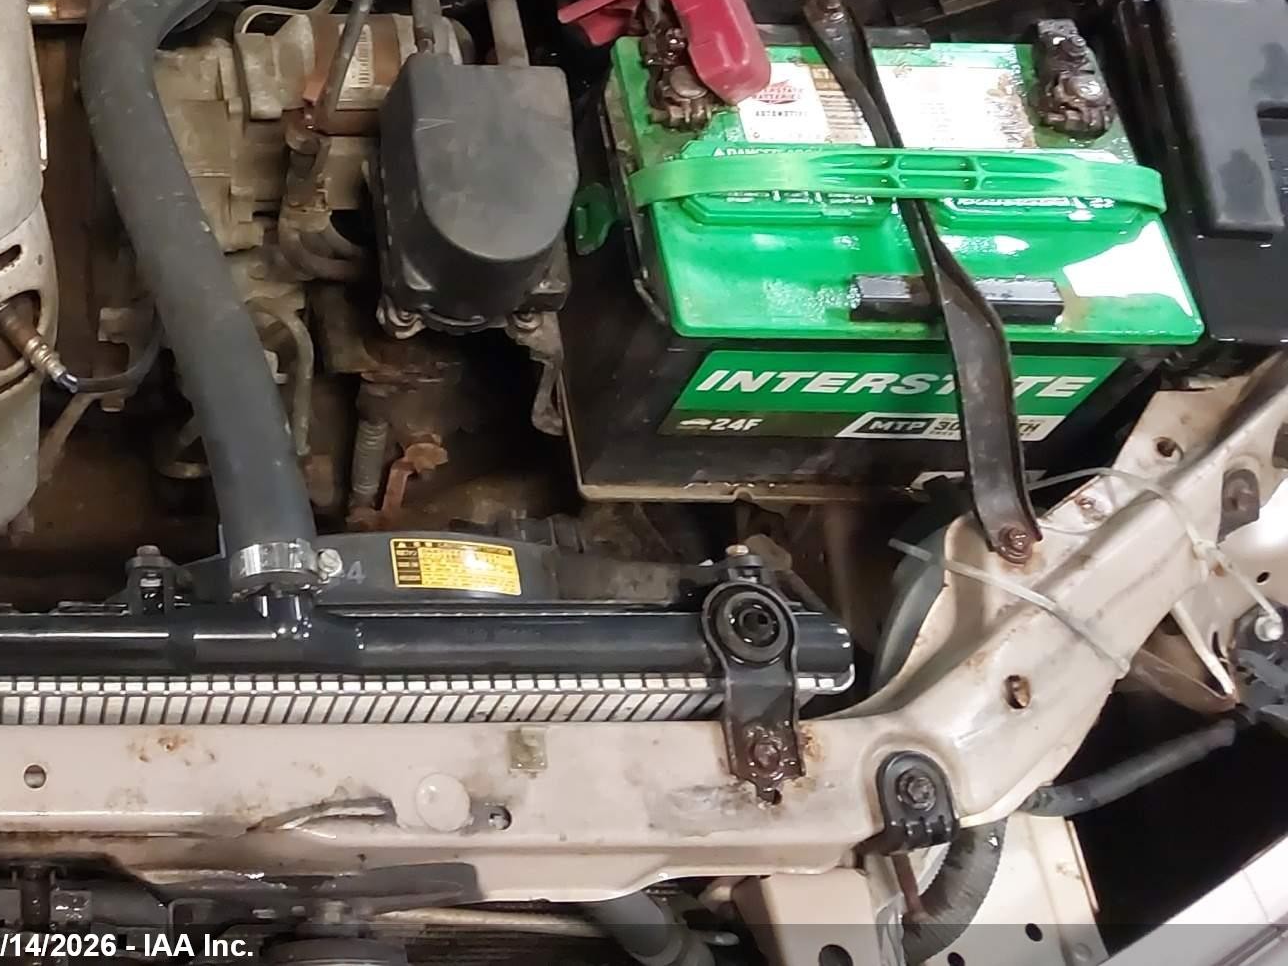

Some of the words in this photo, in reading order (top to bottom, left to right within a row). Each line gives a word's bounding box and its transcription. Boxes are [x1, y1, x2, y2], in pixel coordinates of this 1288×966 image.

[696, 370, 1095, 398] INTERSTTE
[709, 417, 764, 432] 24F
[869, 420, 927, 432] MTP
